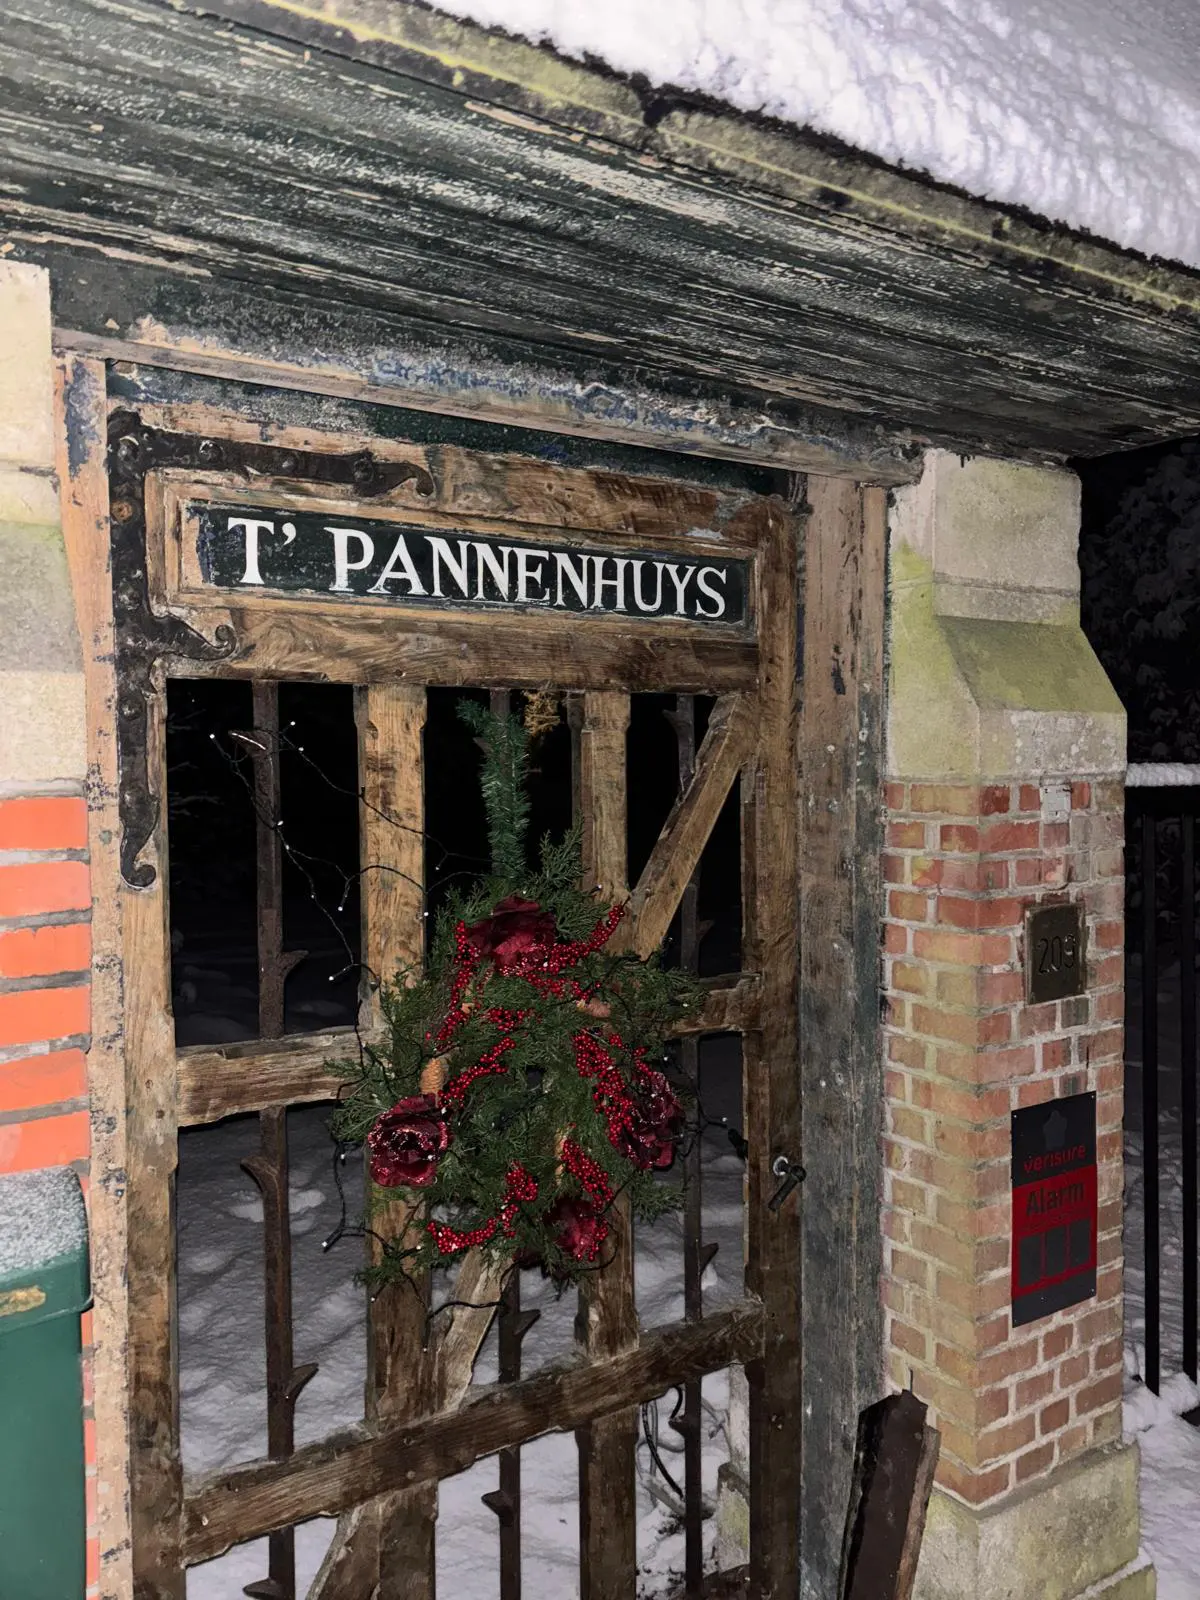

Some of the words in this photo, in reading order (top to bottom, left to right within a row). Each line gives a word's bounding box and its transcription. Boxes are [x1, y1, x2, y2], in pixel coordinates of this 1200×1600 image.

[322, 526, 728, 619] PANNENHUYS
[1037, 933, 1077, 974] 209
[1023, 1143, 1087, 1174] verisure
[1026, 1180, 1085, 1217] Alarm
